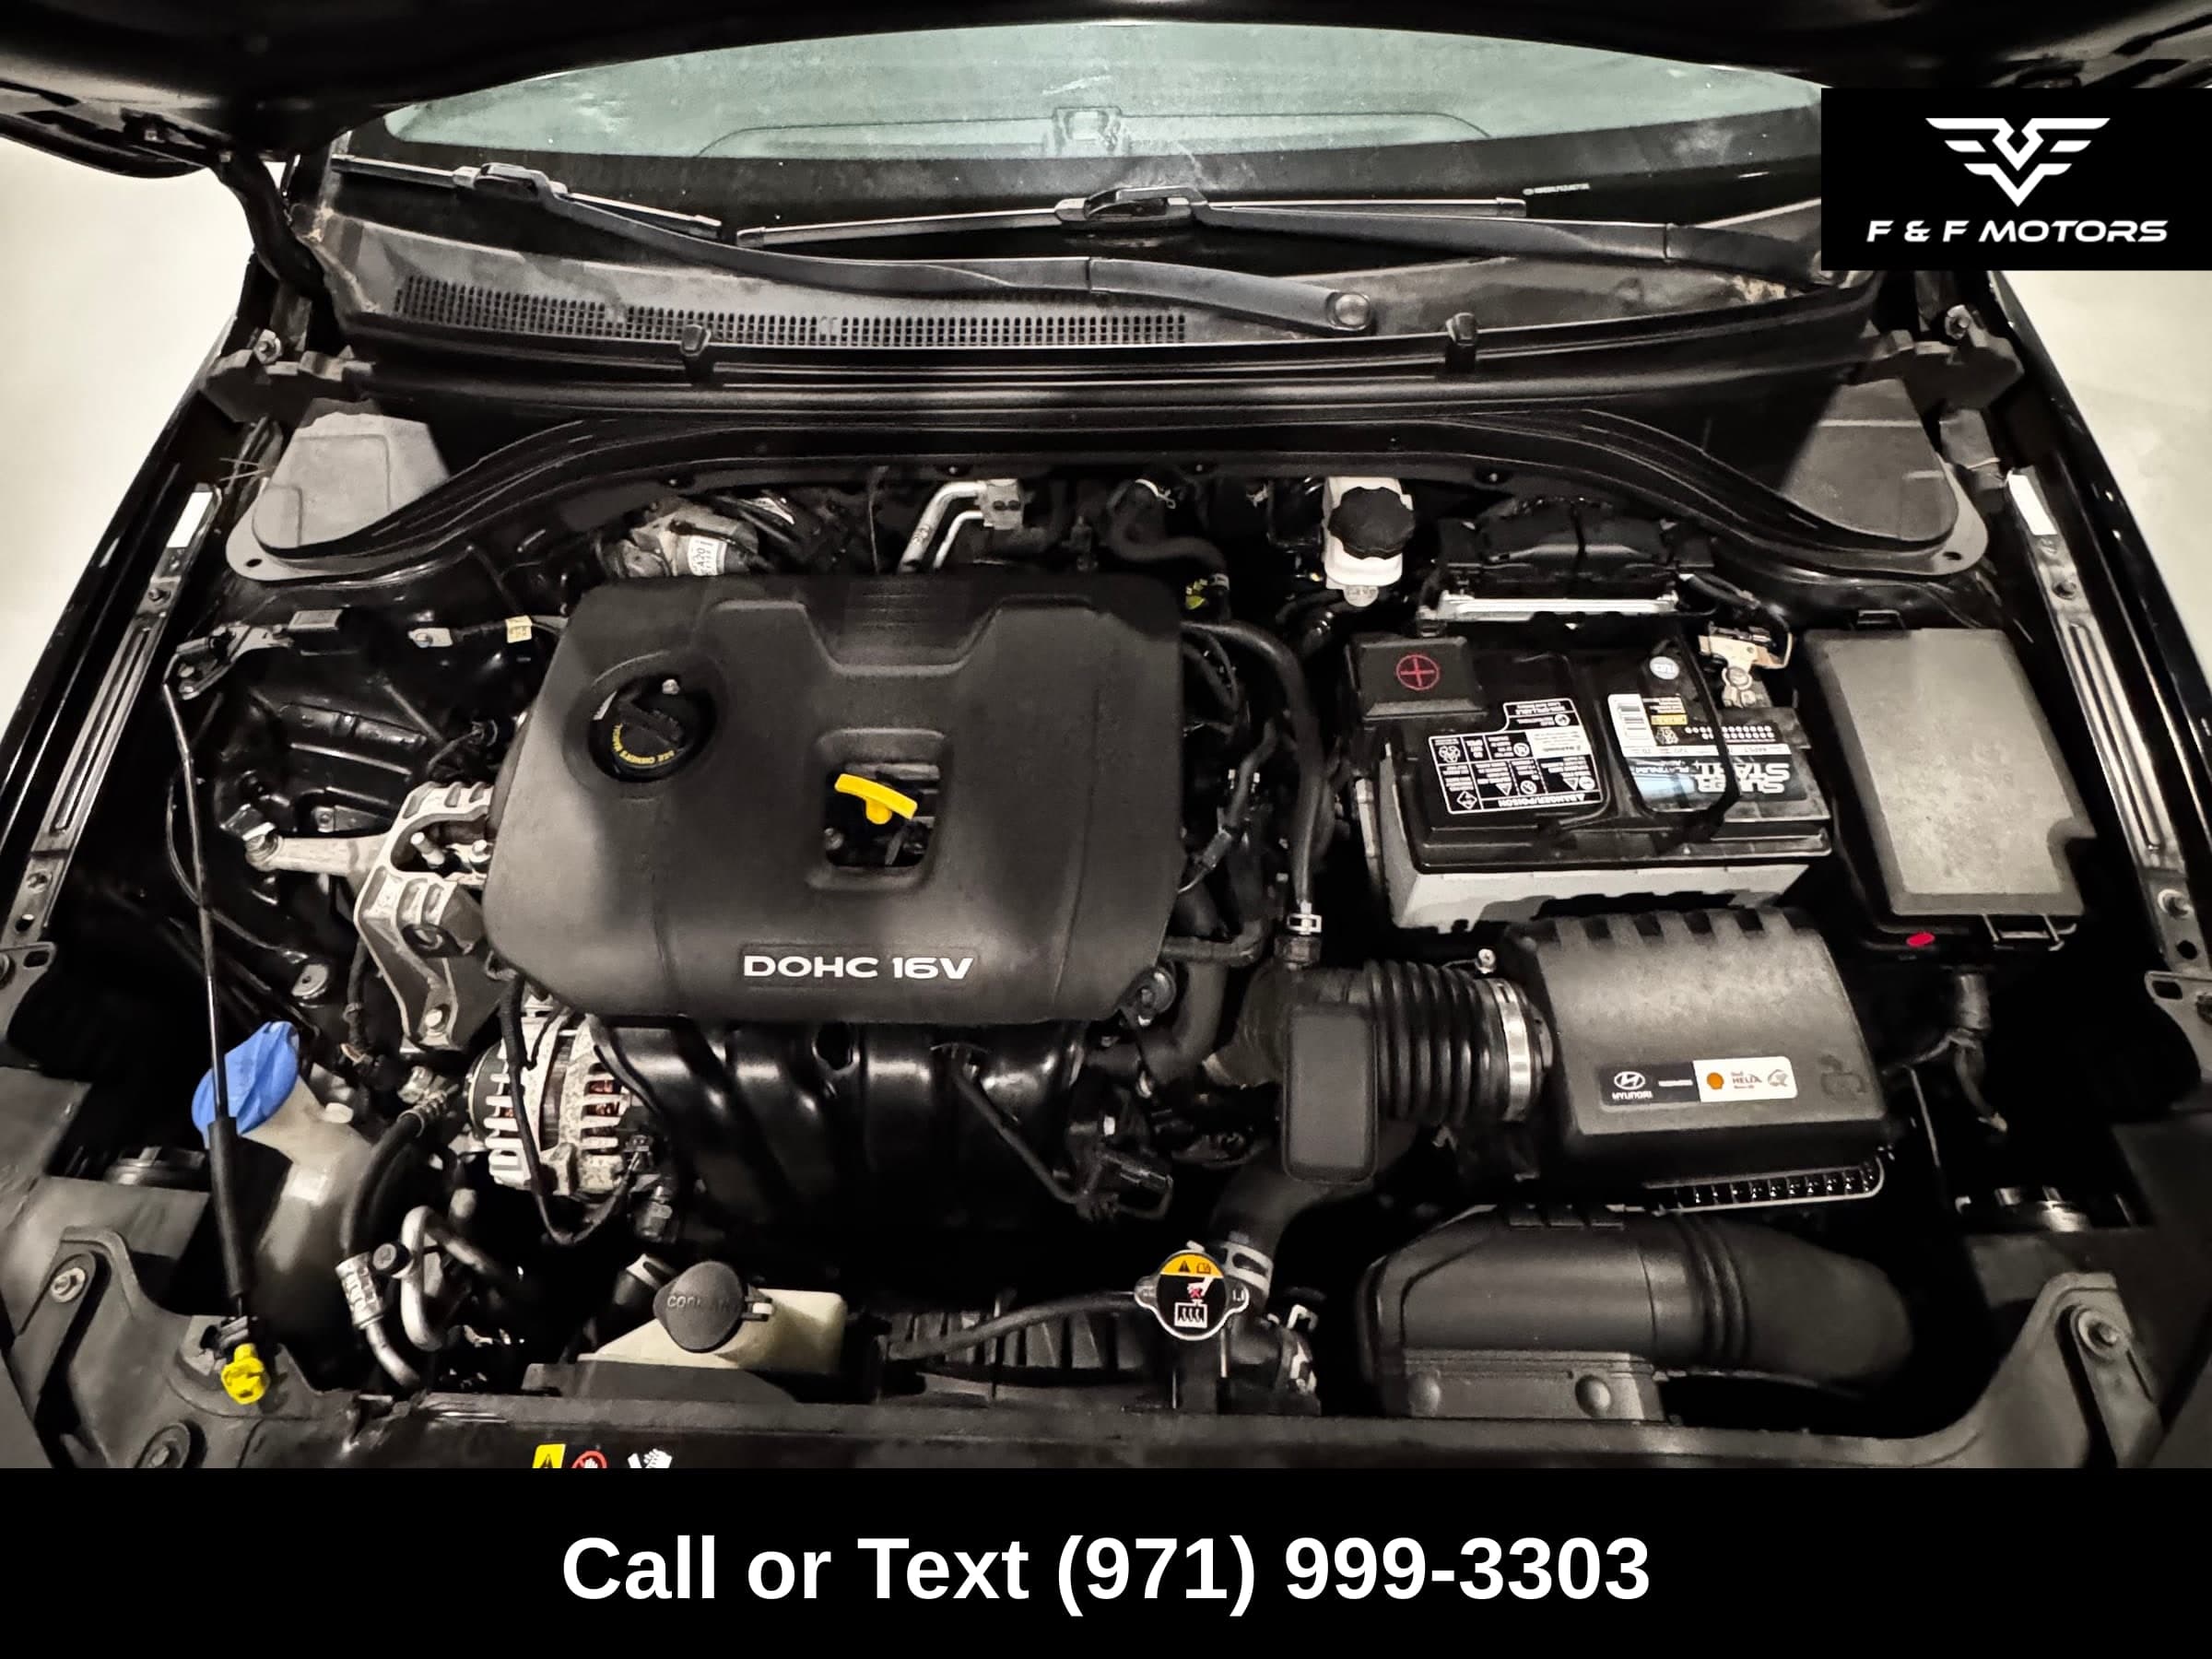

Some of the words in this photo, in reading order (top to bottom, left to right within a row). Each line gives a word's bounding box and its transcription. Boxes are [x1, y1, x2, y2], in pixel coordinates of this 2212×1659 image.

[744, 956, 878, 978] DOHC
[892, 957, 973, 980] 16V
[1611, 1090, 1653, 1100] HYUNDAI
